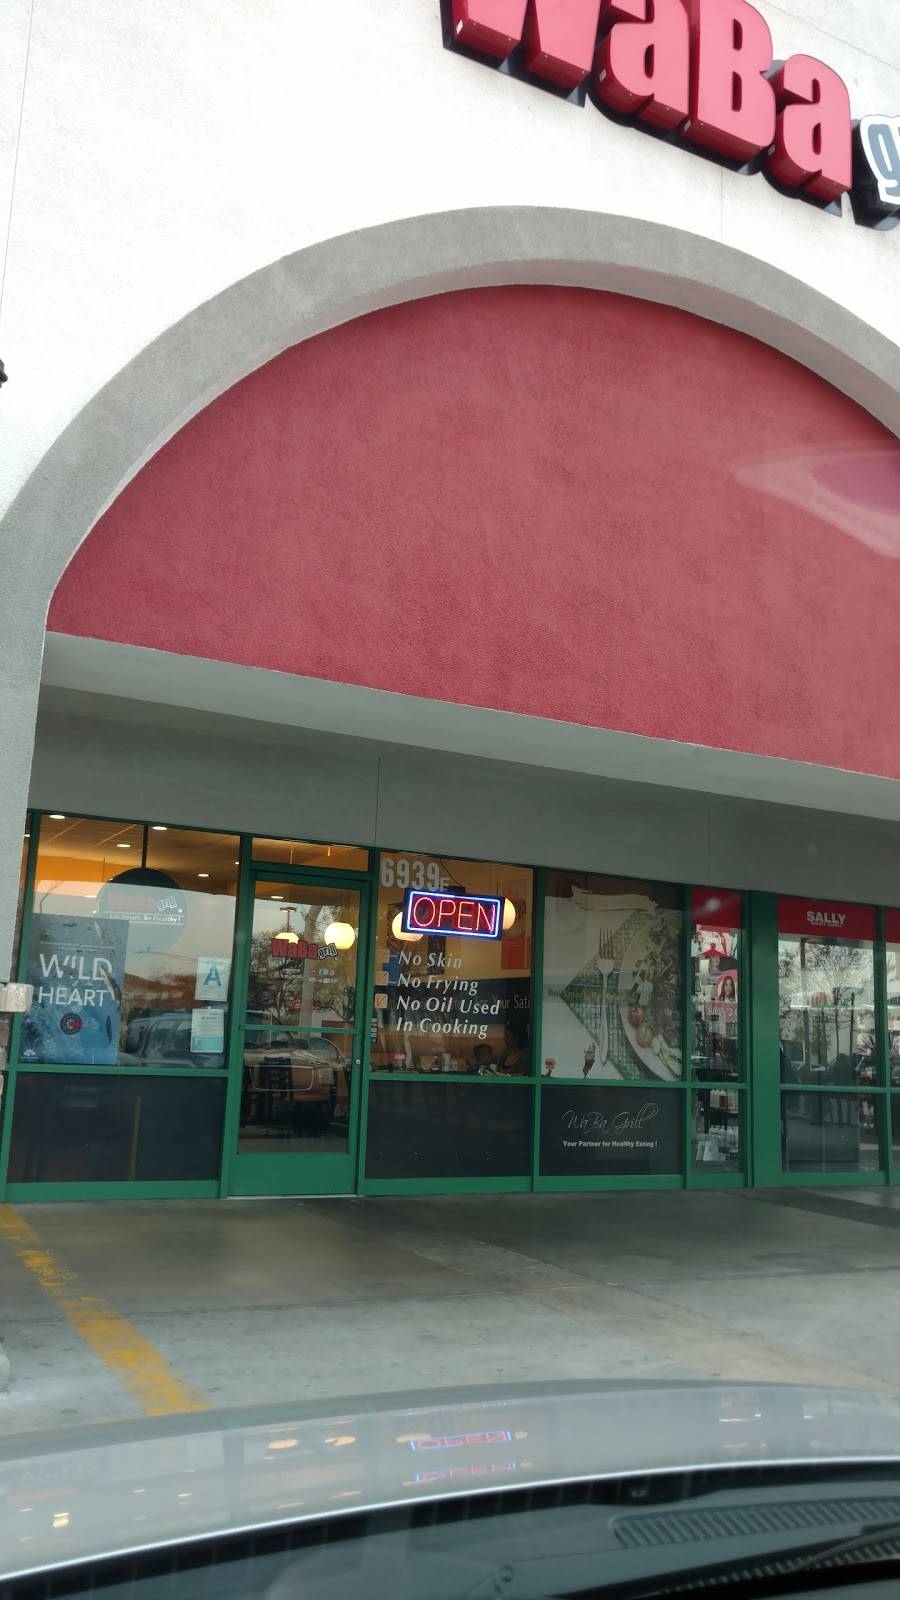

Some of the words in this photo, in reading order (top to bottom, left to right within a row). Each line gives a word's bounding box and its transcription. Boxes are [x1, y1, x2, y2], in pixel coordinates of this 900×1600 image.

[412, 896, 497, 934] OPEN
[806, 911, 846, 925] SALLY
[39, 953, 113, 981] WILD
[398, 951, 422, 966] No
[427, 951, 463, 970] Skin
[203, 962, 222, 986] A
[38, 986, 109, 1007] HEART
[396, 974, 421, 989] No
[426, 975, 479, 997] Frying
[396, 995, 421, 1011] No
[426, 996, 452, 1013] Oil
[459, 998, 501, 1016] Used
[396, 1017, 413, 1033] In
[419, 1018, 489, 1040] Cooking
[562, 1140, 578, 1148] Your
[579, 1140, 601, 1148] Partner
[602, 1140, 611, 1148] for
[612, 1140, 634, 1149] Healthy
